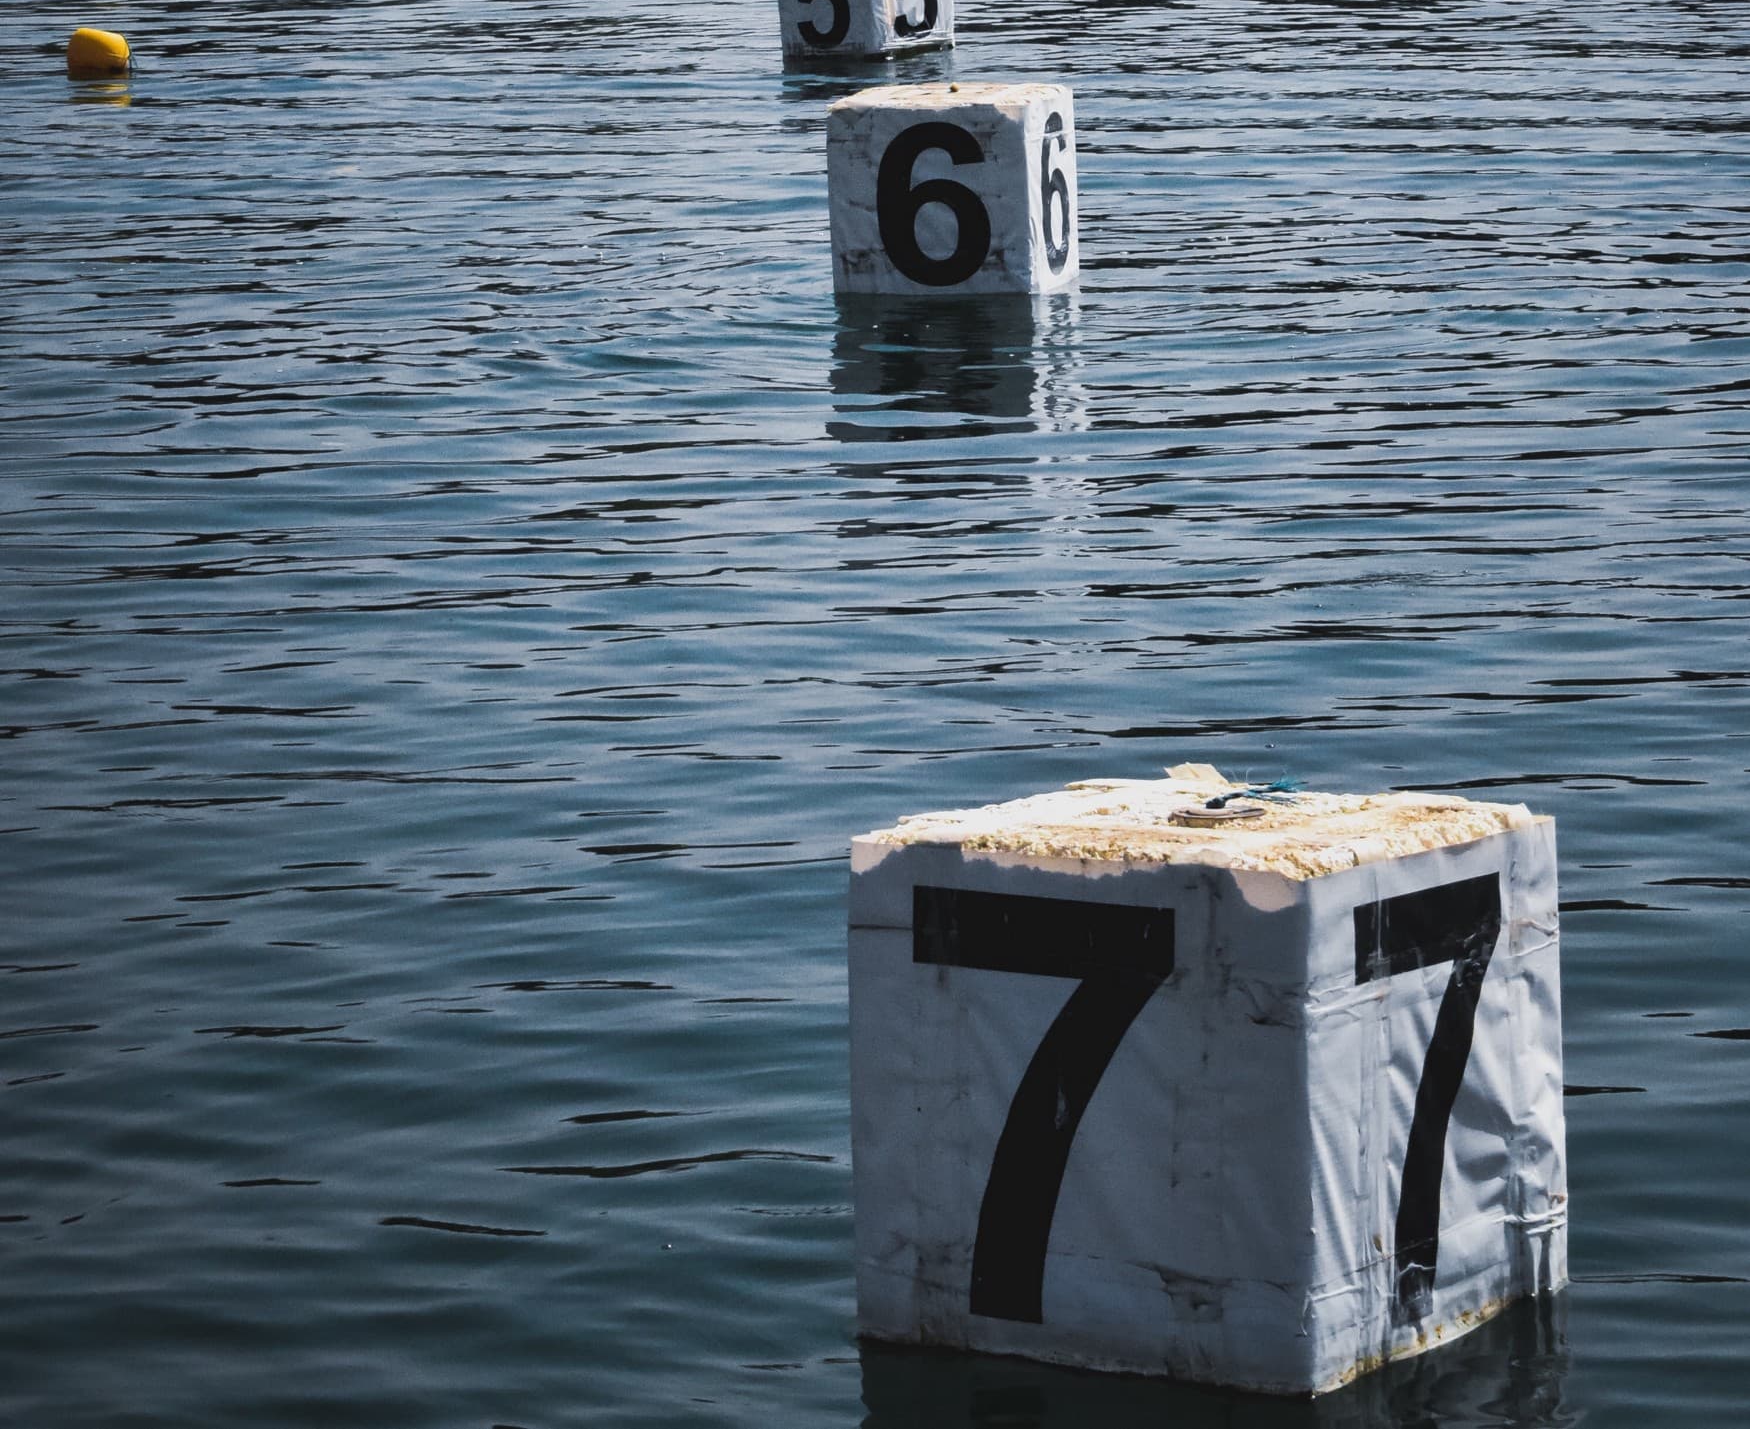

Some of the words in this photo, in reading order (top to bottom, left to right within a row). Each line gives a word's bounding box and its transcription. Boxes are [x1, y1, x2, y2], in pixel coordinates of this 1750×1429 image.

[876, 121, 991, 287] 6
[1041, 111, 1070, 276] 6
[912, 884, 1175, 1325] 7
[1354, 871, 1501, 1326] 7
